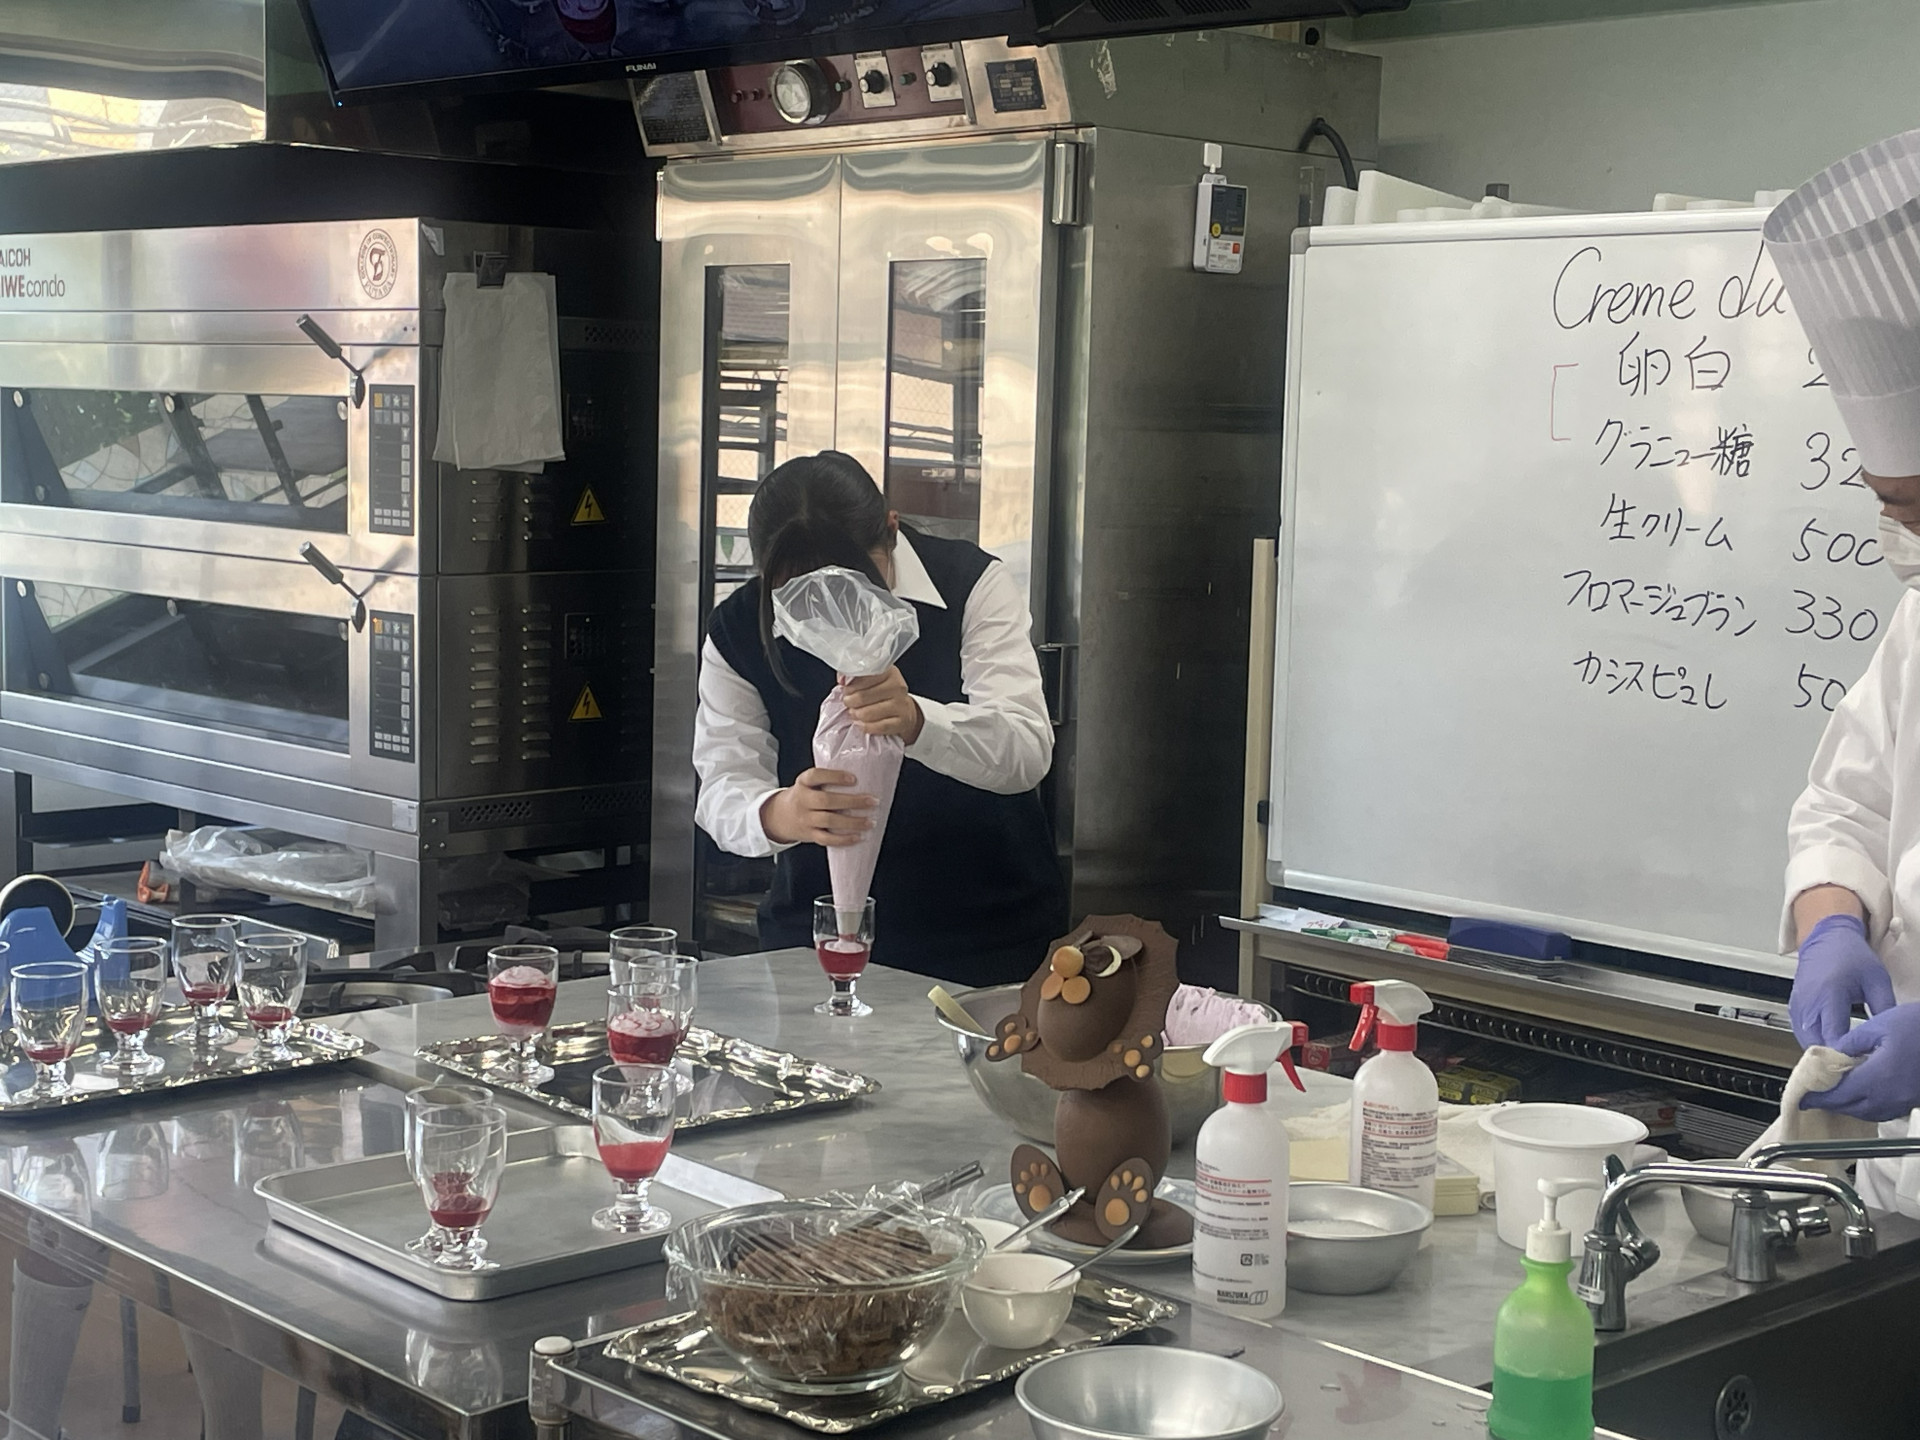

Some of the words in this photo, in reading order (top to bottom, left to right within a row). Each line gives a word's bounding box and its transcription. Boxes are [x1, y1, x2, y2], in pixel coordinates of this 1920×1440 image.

[625, 62, 657, 73] FUNAI
[1553, 246, 1697, 329] Creme
[1617, 331, 1731, 396] 卵白
[1595, 418, 1755, 477] グラニュー糖
[1600, 493, 1733, 551] 生クリーム
[1563, 569, 1757, 637] フロマージュブラン
[1785, 589, 1879, 641] 330
